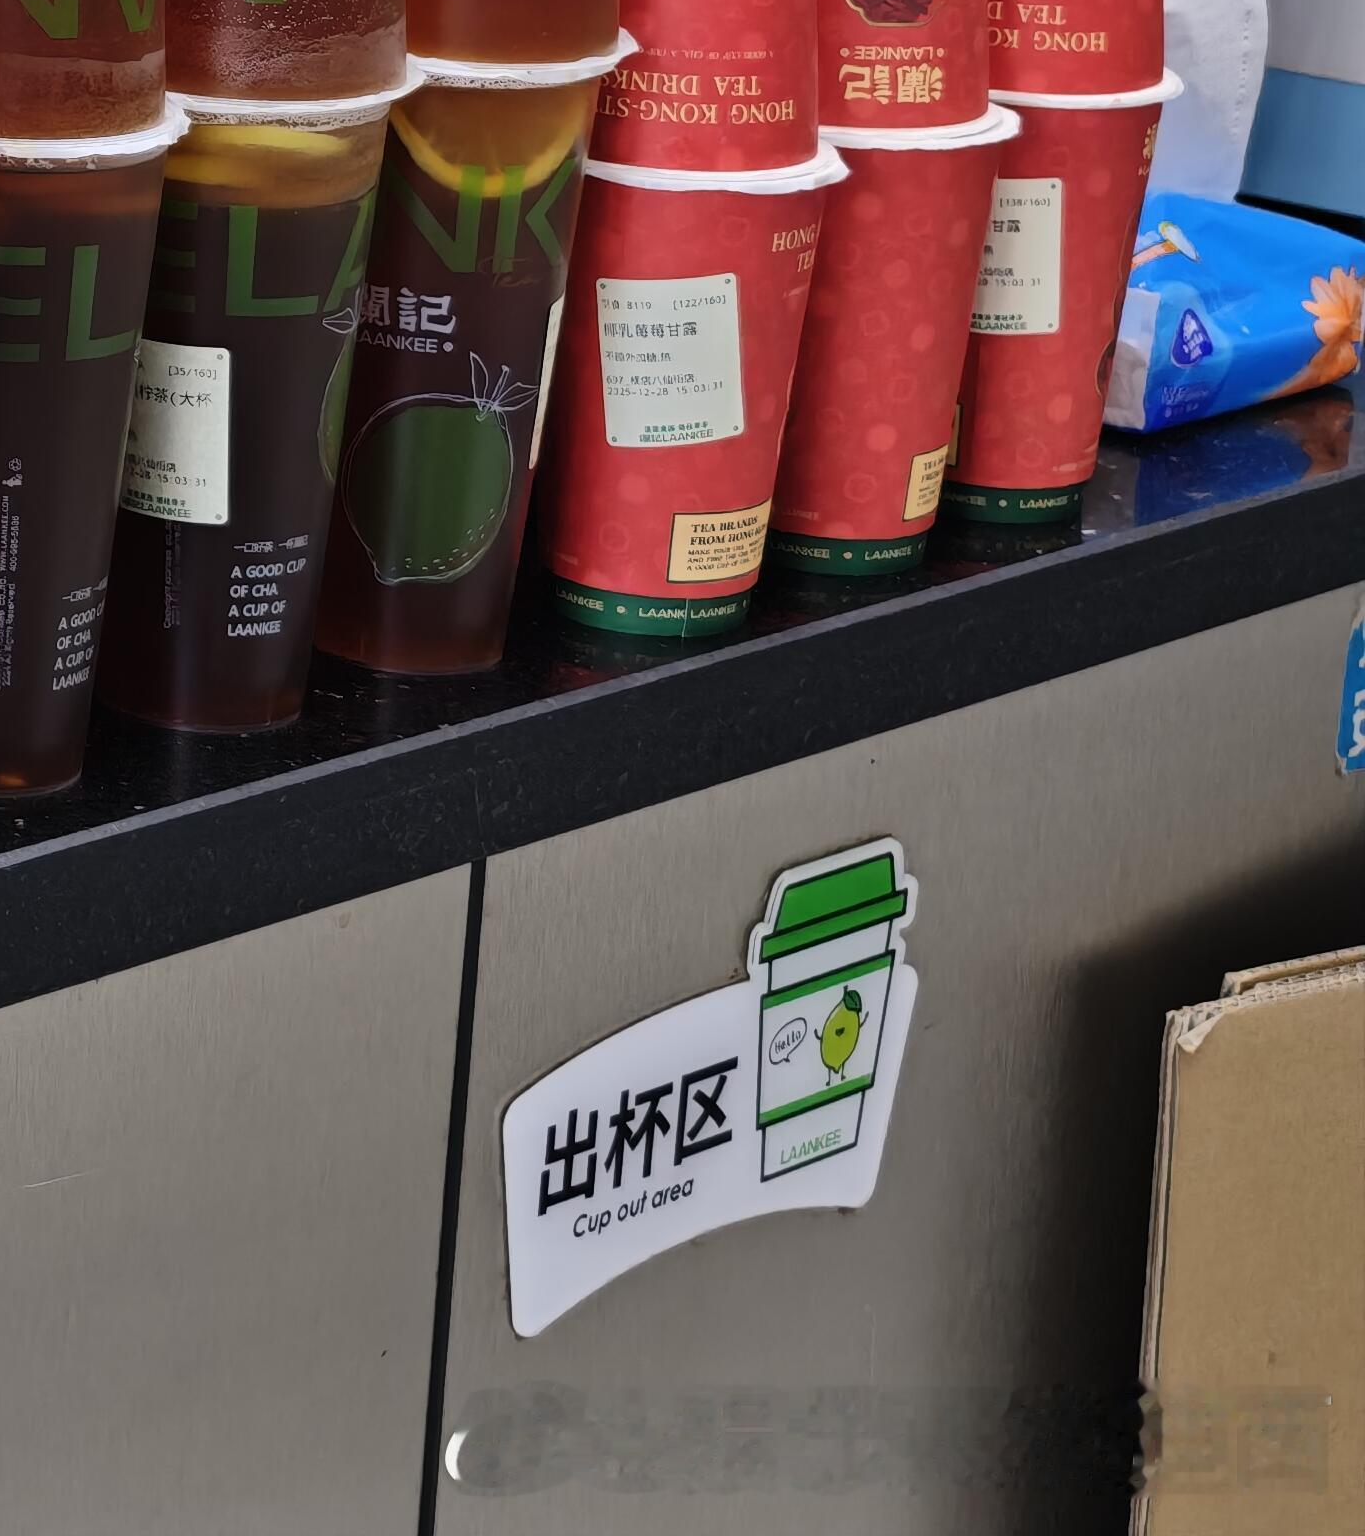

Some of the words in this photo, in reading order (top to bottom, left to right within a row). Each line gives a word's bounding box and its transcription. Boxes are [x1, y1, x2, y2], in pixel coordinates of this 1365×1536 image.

[1017, 1, 1067, 26] TEA
[854, 45, 935, 61] LAANKEE
[1033, 30, 1107, 54] HONG
[714, 71, 761, 96] TEA
[731, 99, 794, 125] HONG
[246, 563, 283, 578] GOOD
[287, 558, 306, 574] CUP
[230, 585, 248, 598] OF
[252, 583, 278, 596] CHA
[243, 603, 268, 617] CUP
[271, 600, 286, 614] OF
[228, 620, 282, 637] LAANKEE
[772, 1027, 803, 1057] Hello
[537, 1057, 739, 1216] 出杯区
[779, 1127, 843, 1167] LAANKEE
[571, 1212, 614, 1239] Cup
[616, 1192, 653, 1218] out
[652, 1176, 695, 1210] area
